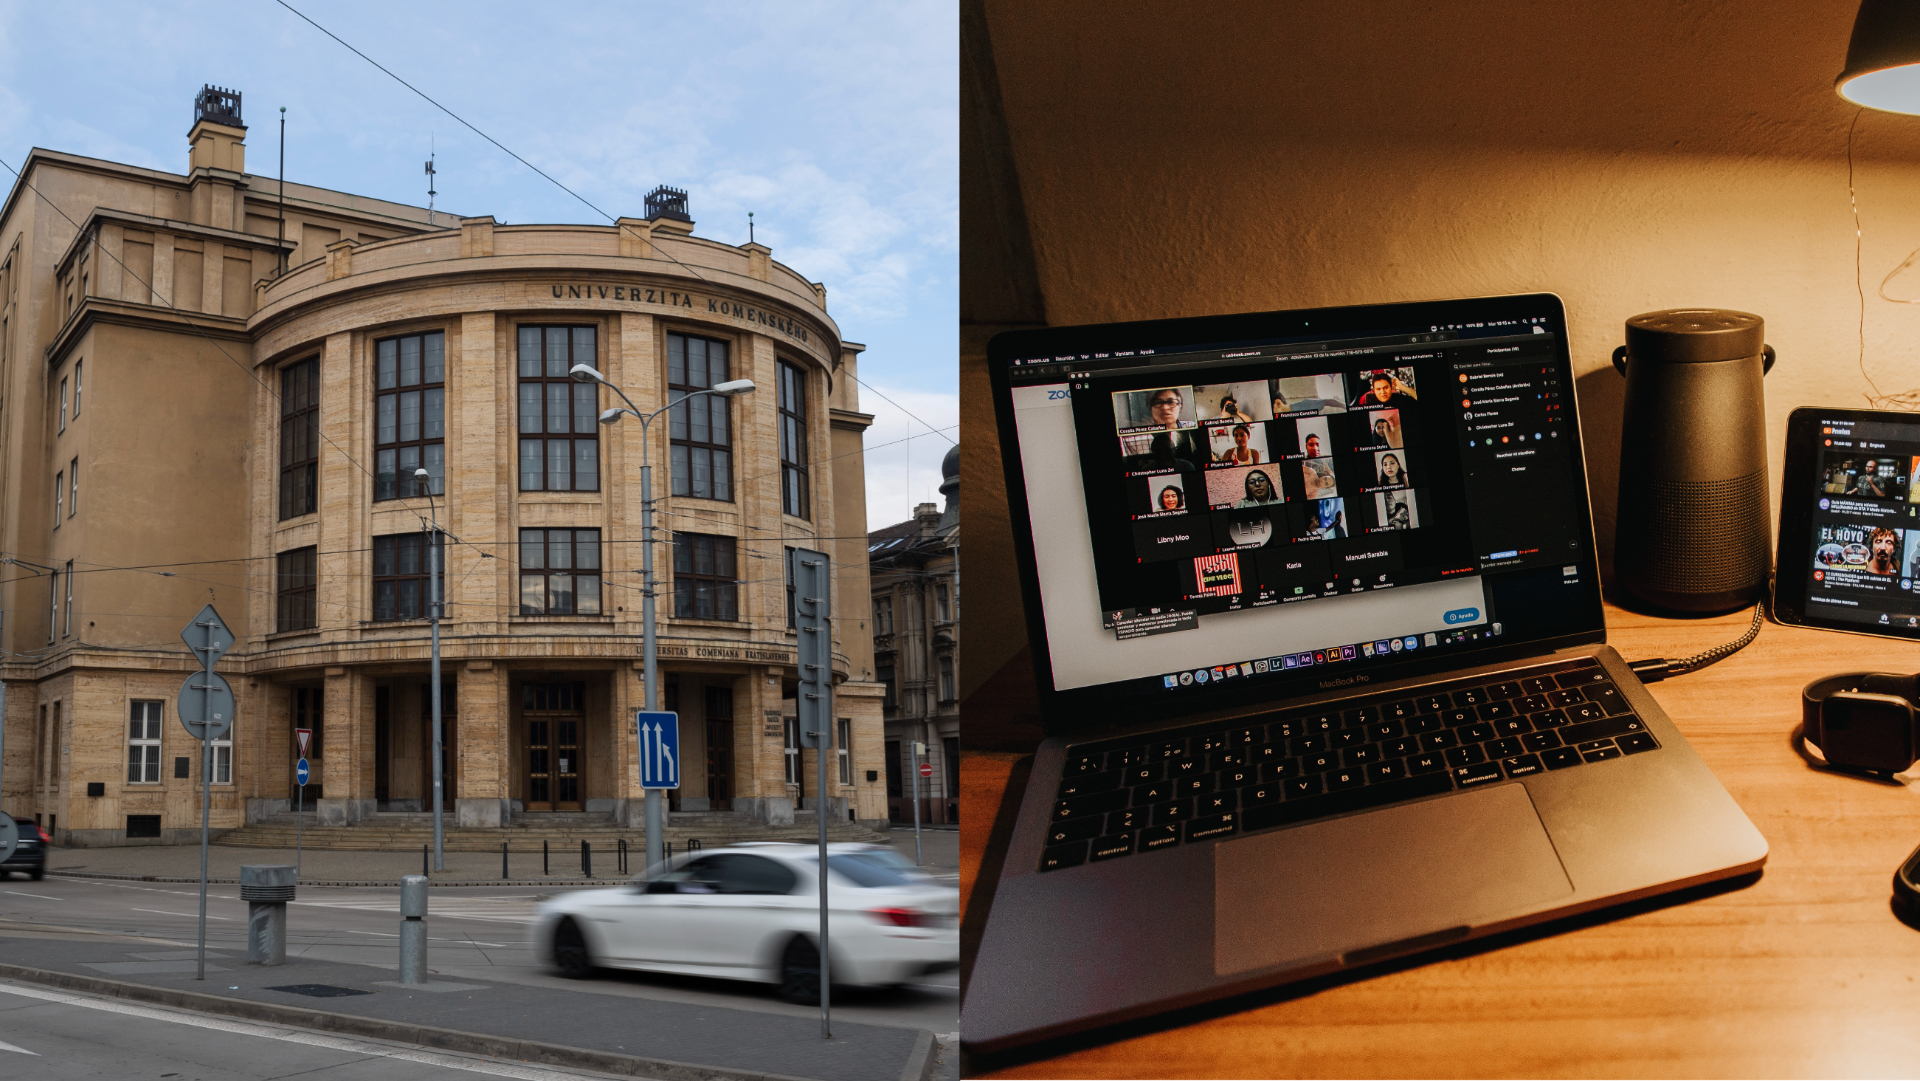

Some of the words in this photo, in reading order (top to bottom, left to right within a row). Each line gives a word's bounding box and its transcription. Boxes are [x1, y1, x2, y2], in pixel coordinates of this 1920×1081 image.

[552, 285, 693, 308] UNIVERZITA
[708, 298, 808, 343] KOMENSKÉHO
[1822, 528, 1834, 540] EL
[1836, 528, 1864, 542] HOYO
[1346, 552, 1366, 561] Manuel
[636, 646, 688, 656] UERSITAS
[697, 648, 739, 658] COMENIANA
[746, 651, 790, 662] BRATISLAVENSIS
[1330, 650, 1338, 658] Ai
[1344, 648, 1352, 656] Pr
[1320, 677, 1355, 688] MacBook
[1356, 674, 1370, 682] Pro
[1512, 766, 1536, 774] option
[1462, 772, 1498, 784] command
[1193, 825, 1232, 838] command
[1148, 837, 1176, 846] option
[1098, 846, 1128, 856] control
